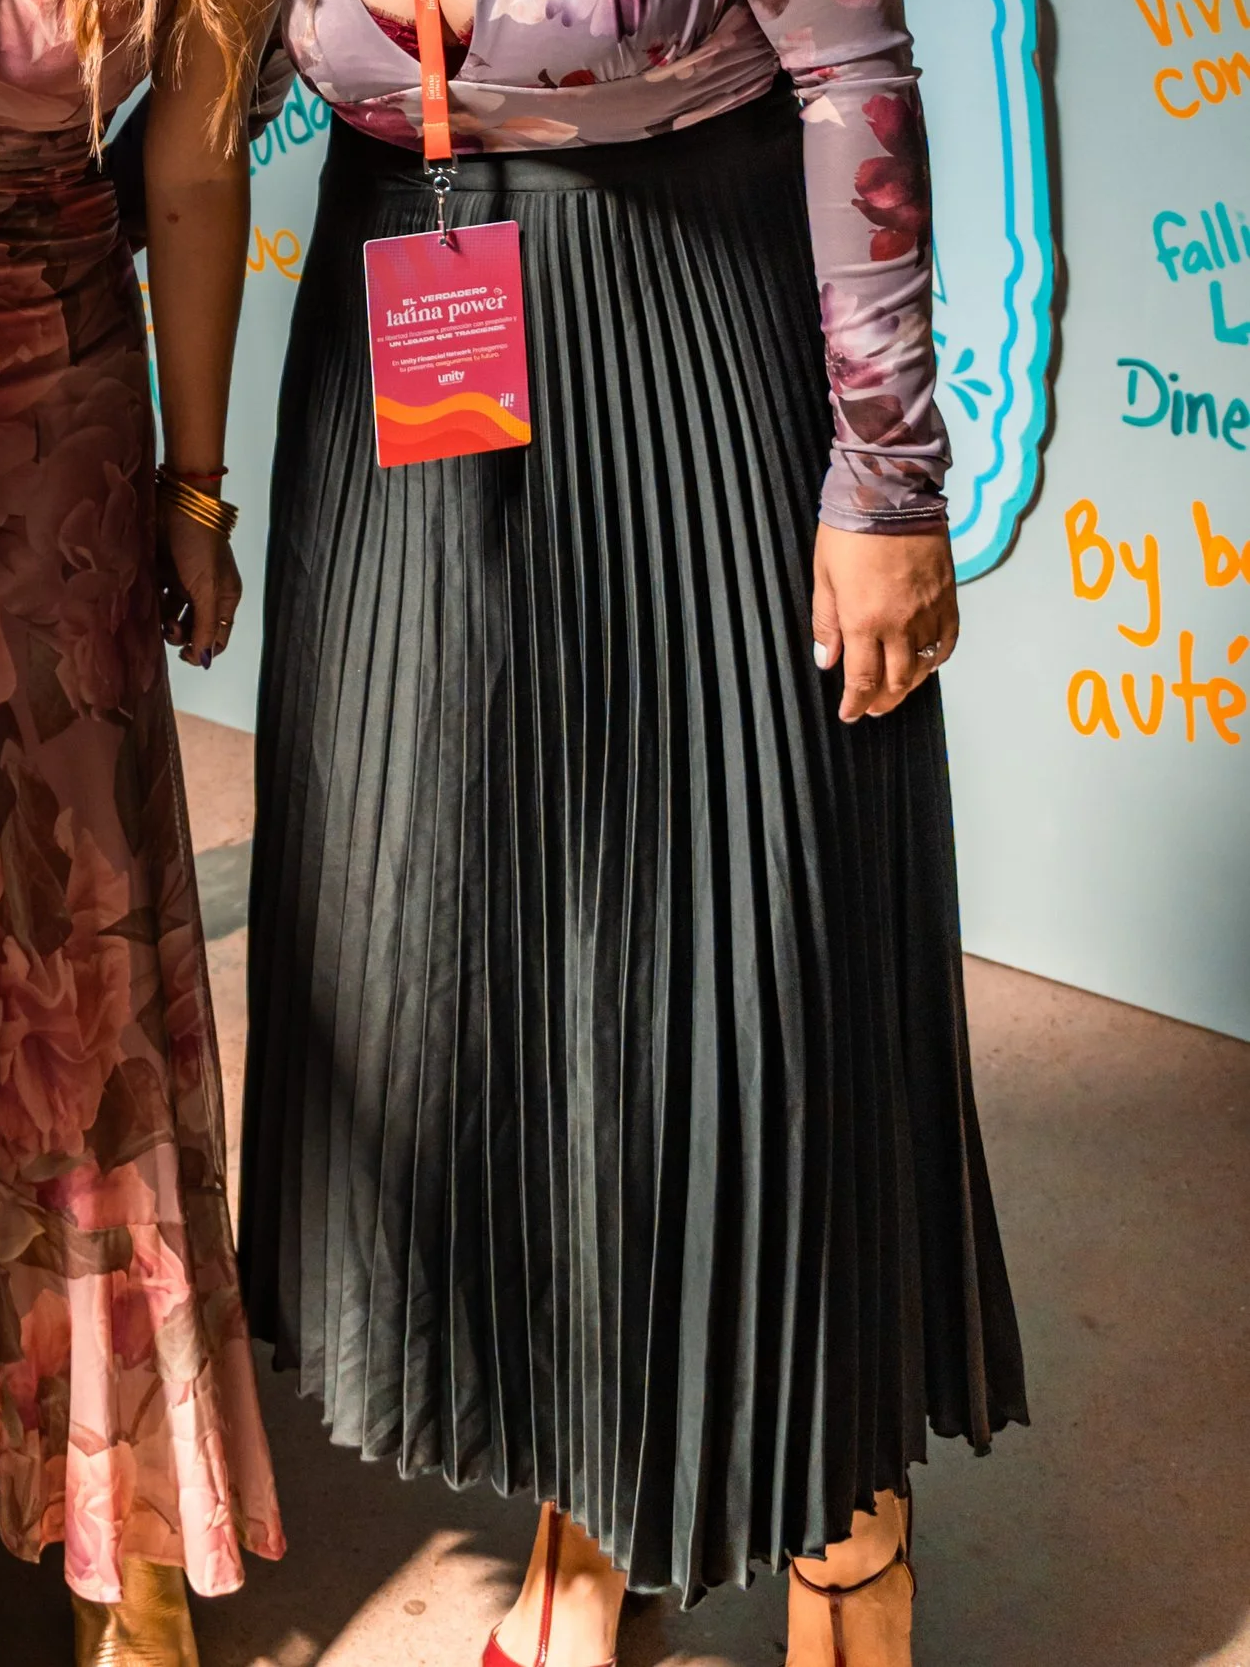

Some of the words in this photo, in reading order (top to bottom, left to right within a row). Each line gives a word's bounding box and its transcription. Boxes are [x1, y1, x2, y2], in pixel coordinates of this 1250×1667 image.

[402, 298, 418, 307] EL
[420, 286, 488, 304] VERDADERO
[448, 295, 508, 323] power
[438, 370, 465, 383] unity
[1064, 498, 1162, 648] By
